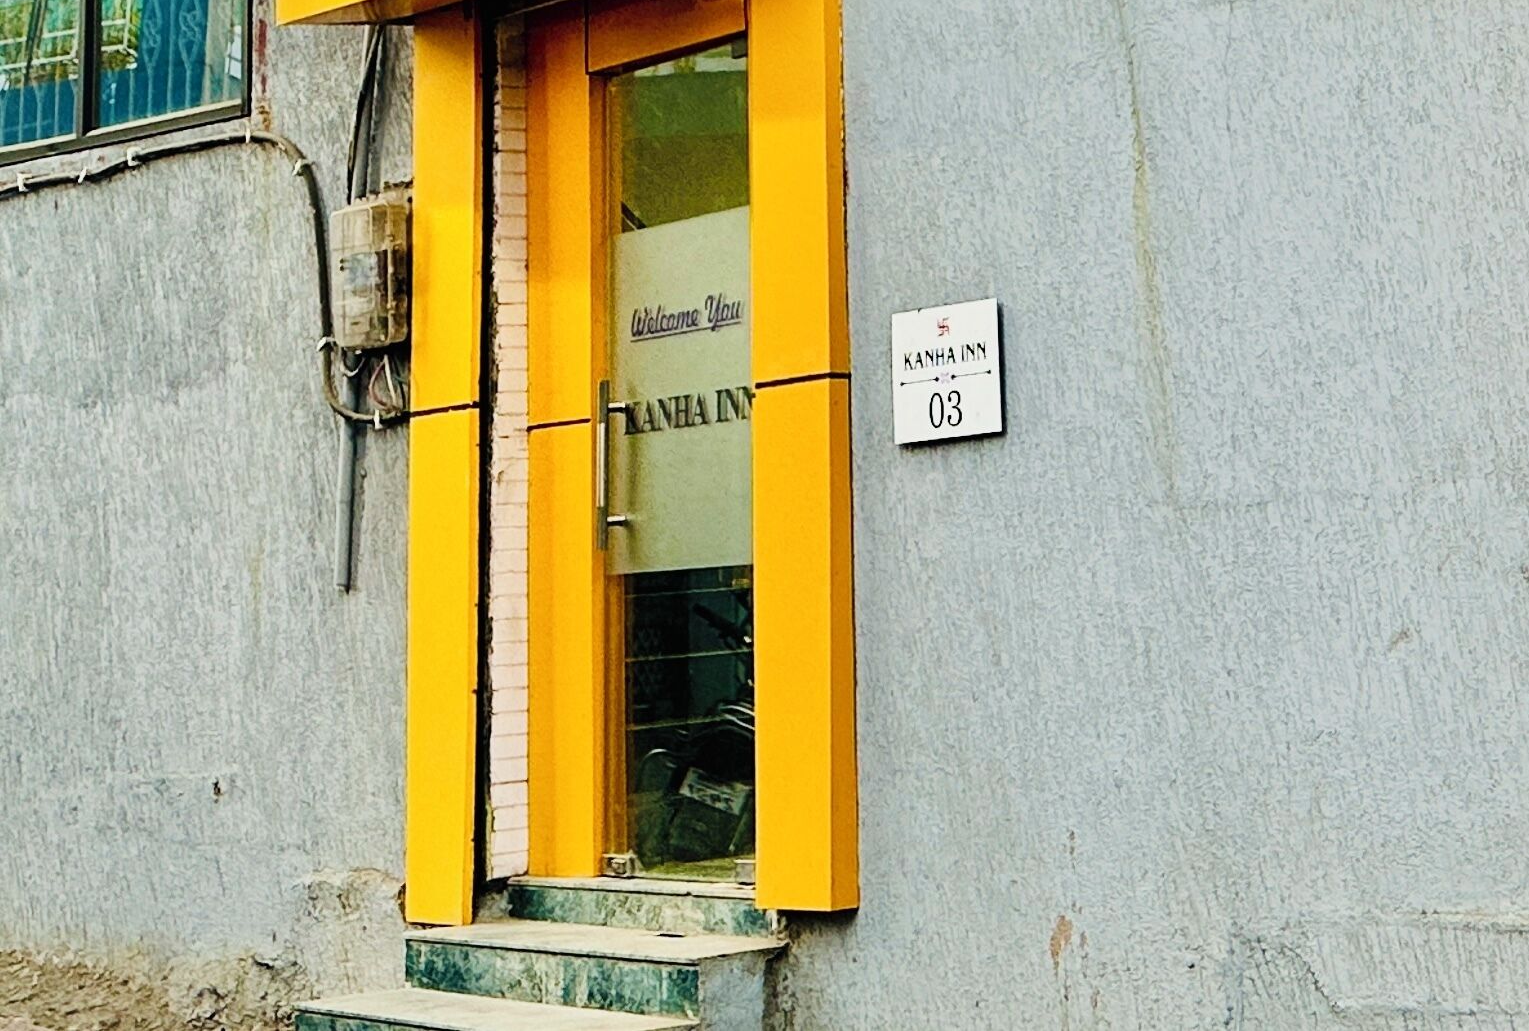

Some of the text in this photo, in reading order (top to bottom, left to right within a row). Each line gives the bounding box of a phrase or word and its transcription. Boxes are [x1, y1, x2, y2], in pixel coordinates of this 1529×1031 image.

[631, 293, 741, 338] Welcome You
[904, 341, 987, 371] KANHA INN
[624, 392, 712, 436] KANHA
[929, 390, 963, 428] 03
